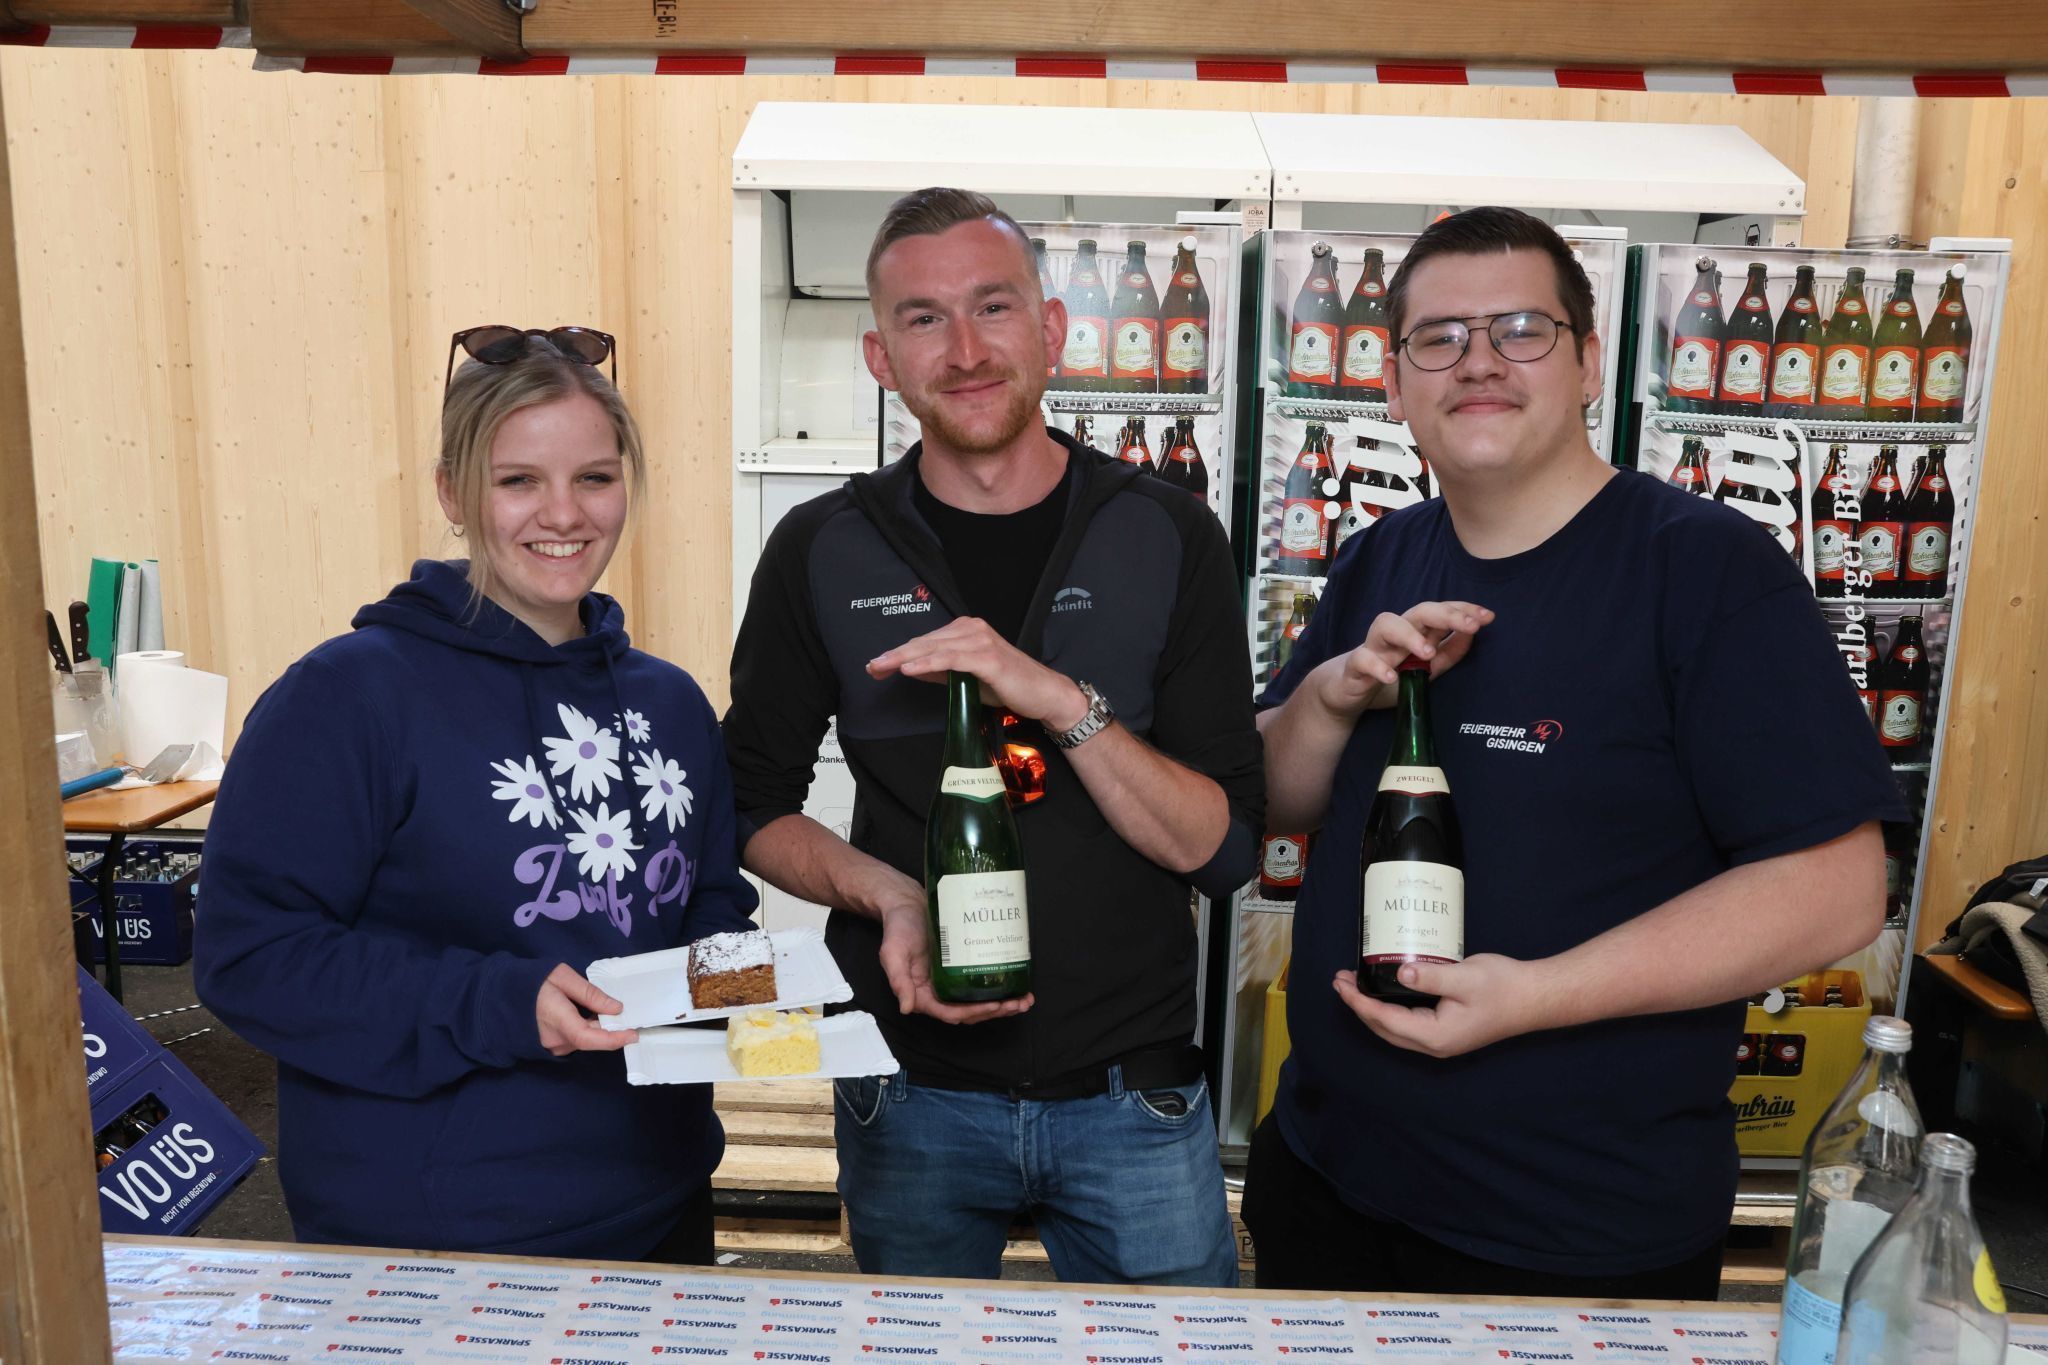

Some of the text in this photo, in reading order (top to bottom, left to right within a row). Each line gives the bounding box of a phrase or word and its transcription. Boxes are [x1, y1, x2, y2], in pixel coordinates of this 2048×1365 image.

[1833, 450, 1874, 698] arlberger Bier
[851, 593, 912, 609] FEUERWEHR
[1051, 600, 1092, 613] skinfit
[882, 602, 931, 616] GISINGEN
[1459, 723, 1526, 738] FEUERWEHR
[1486, 738, 1546, 754] GISINGEN
[819, 756, 846, 764] Danke
[947, 778, 977, 787] GRÜNER
[1396, 775, 1435, 783] ZWEIGELT
[1384, 898, 1450, 916] MÜLLER
[962, 906, 1022, 924] MÜLLER
[124, 918, 152, 939] ÜS
[1397, 925, 1439, 937] Zweigelt
[1734, 1094, 1796, 1119] nbräu
[1735, 1120, 1788, 1133] arlberger Bier
[99, 1122, 215, 1221] VO ÜS
[160, 1171, 217, 1225] NICHT VON IRGENDWO
[294, 1270, 352, 1280] SPARKASSE
[397, 1265, 456, 1275] SPARKASSE
[602, 1275, 662, 1287] SPARKASSE
[684, 1281, 755, 1291] Guten Appetit
[500, 1282, 559, 1292] SPARKASSE
[768, 1283, 822, 1293] Stimmung
[271, 1294, 333, 1305] SPARKASSE
[378, 1290, 440, 1300] SPARKASSE
[685, 1293, 746, 1303] SPARKASSE
[884, 1291, 944, 1300] SPARKASSE
[964, 1293, 1034, 1303] Unterhaltung
[590, 1302, 652, 1313] SPARKASSE
[782, 1298, 843, 1308] SPARKASSE
[864, 1299, 961, 1313] Gute Unterhaltung
[1096, 1300, 1157, 1309] SPARKASSE
[1178, 1303, 1250, 1313] Guten Appetit
[484, 1306, 545, 1318] SPARKASSE
[673, 1307, 747, 1318] Guten Appetit
[760, 1311, 817, 1321] Stimmung
[996, 1306, 1057, 1317] SPARKASSE
[1080, 1309, 1152, 1321] Guten Appetit
[1379, 1310, 1440, 1319] SPARKASSE
[359, 1315, 422, 1326] SPARKASSE
[675, 1319, 738, 1330] SPARKASSE
[880, 1316, 941, 1327] SPARKASSE
[1186, 1316, 1248, 1324] SPARKASSE
[1284, 1319, 1345, 1327] SPARKASSE
[1590, 1315, 1652, 1324] SPARKASSE
[577, 1329, 640, 1338] SPARKASSE
[775, 1324, 837, 1334] SPARKASSE
[859, 1328, 930, 1339] Unterhaltung
[1098, 1325, 1160, 1336] SPARKASSE
[1498, 1325, 1559, 1333] SPARKASSE
[1686, 1329, 1749, 1338] SPARKASSE
[467, 1336, 531, 1347] SPARKASSE
[663, 1333, 738, 1345] Guten Appetit
[752, 1339, 839, 1350] Gute Stimmung
[995, 1335, 1058, 1344] SPARKASSE
[1389, 1335, 1452, 1344] SPARKASSE
[339, 1344, 404, 1355] SPARKASSE
[665, 1346, 729, 1356] SPARKASSE
[875, 1346, 938, 1355] SPARKASSE
[1191, 1342, 1254, 1351] SPARKASSE
[1291, 1346, 1354, 1354] SPARKASSE
[1606, 1341, 1669, 1352] SPARKASSE
[225, 1350, 290, 1361] SPARKASSE
[767, 1351, 831, 1363] SPARKASSE
[1100, 1355, 1164, 1364] SPARKASSE
[1511, 1350, 1574, 1360] SPARKASSE
